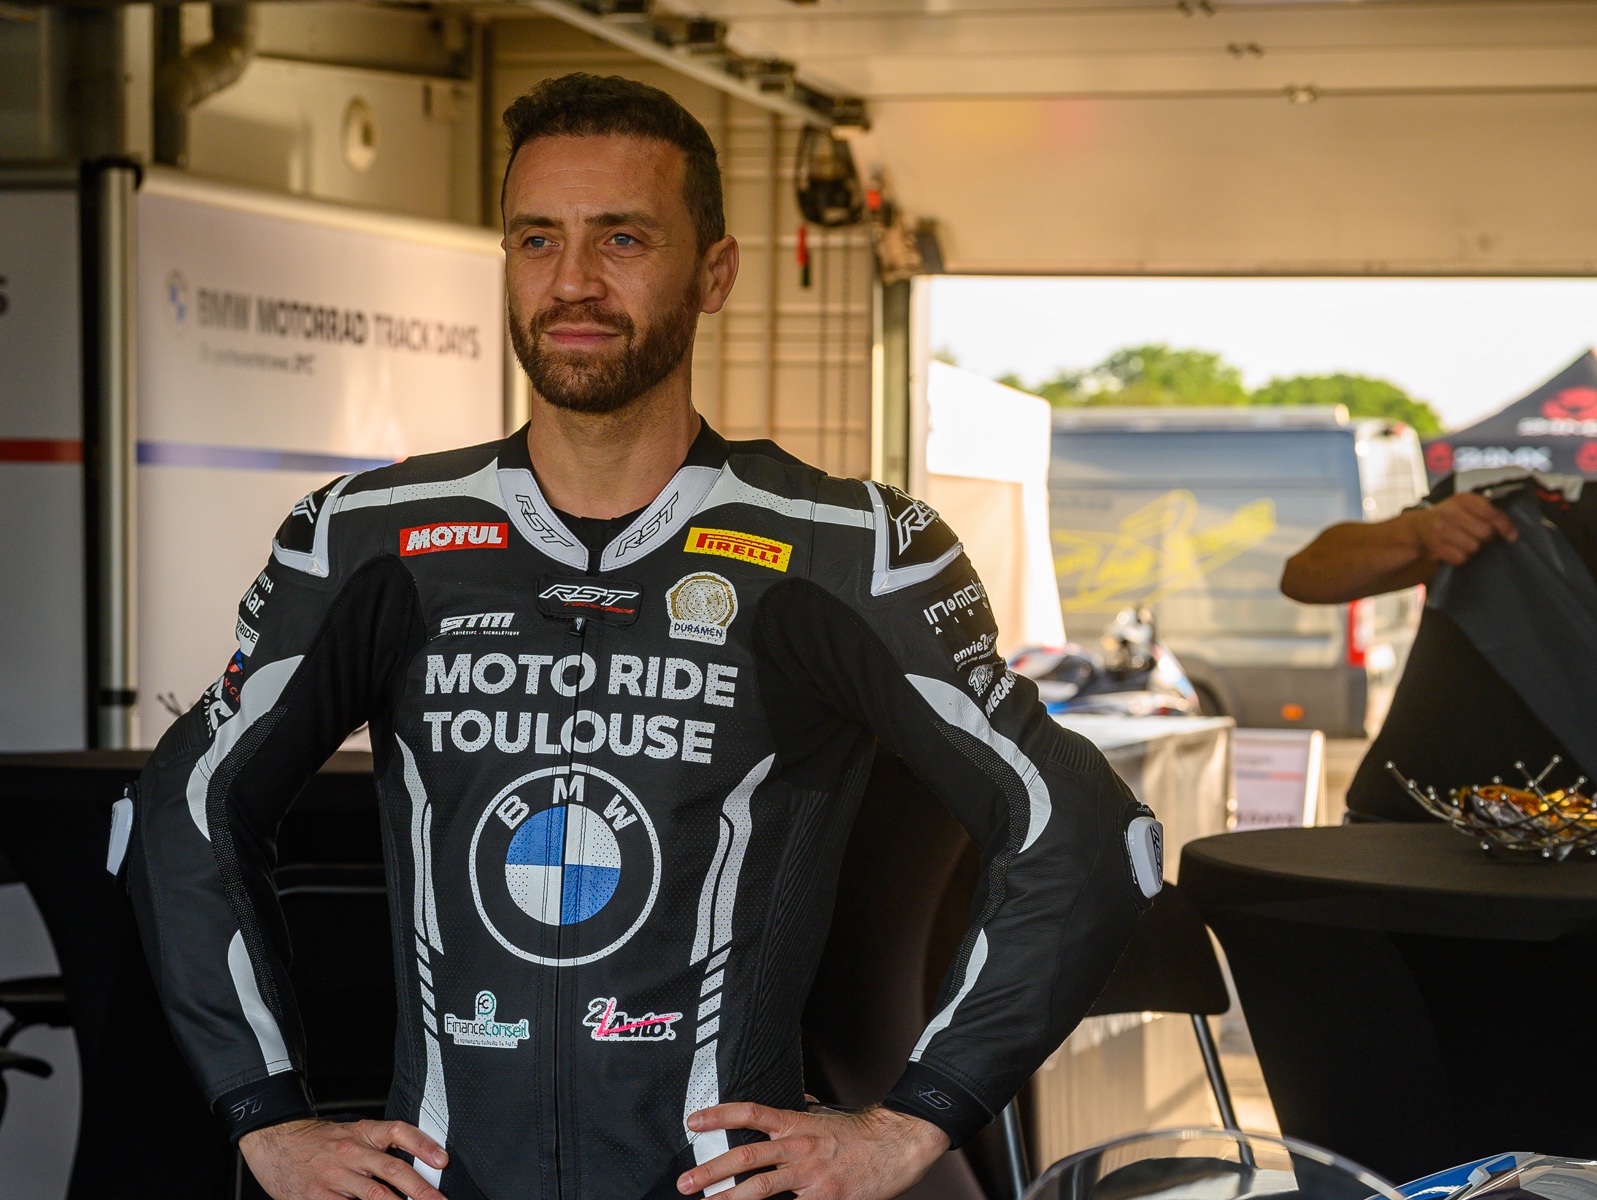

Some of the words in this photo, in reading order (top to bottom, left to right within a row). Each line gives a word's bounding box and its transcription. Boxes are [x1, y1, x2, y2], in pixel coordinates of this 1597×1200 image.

[406, 524, 503, 551] MOTUL
[515, 494, 574, 549] RST
[615, 490, 679, 558] RST
[695, 532, 783, 564] PIRELLI
[538, 584, 640, 606] RST
[440, 612, 516, 633] STM
[674, 623, 723, 638] DURAMEN
[425, 652, 597, 697] MOTO
[607, 654, 740, 708] RIDE
[423, 710, 716, 765] TOULOUSE
[495, 774, 638, 832] BMW
